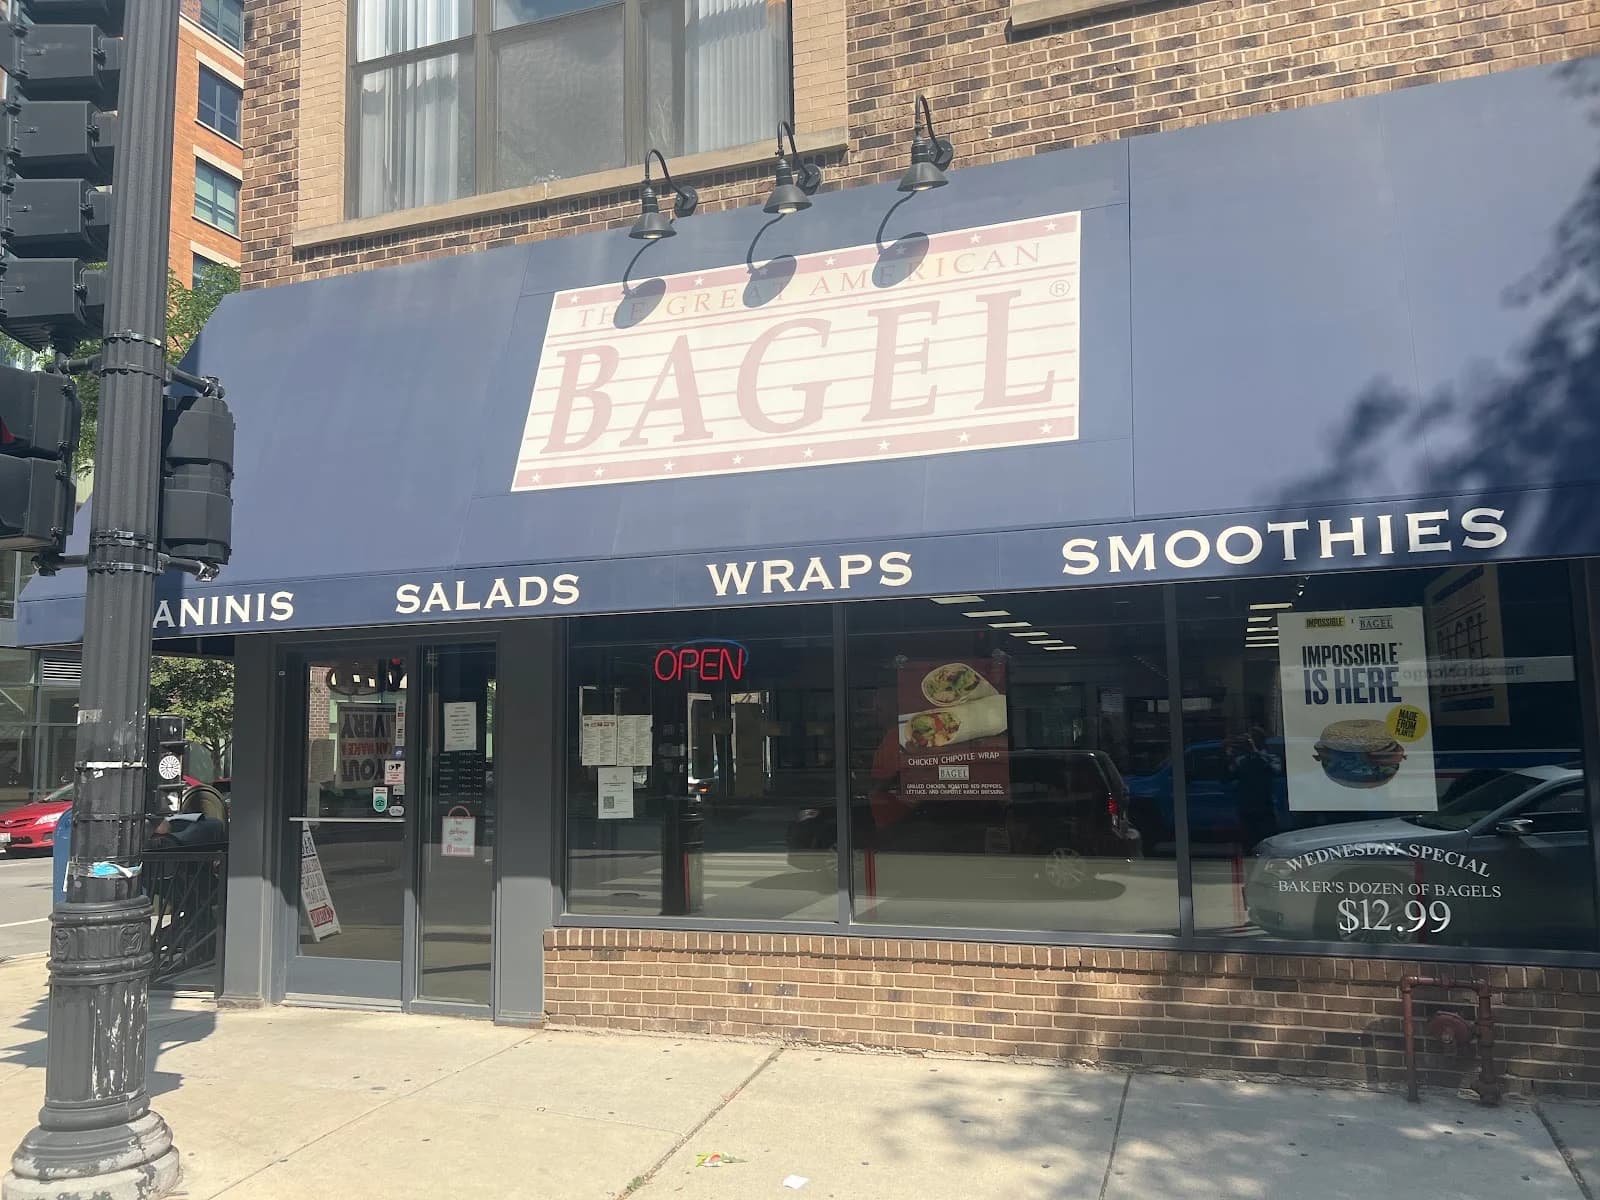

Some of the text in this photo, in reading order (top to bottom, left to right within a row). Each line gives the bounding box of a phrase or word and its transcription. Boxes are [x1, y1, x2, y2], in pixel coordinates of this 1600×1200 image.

[578, 242, 1041, 328] THE GREAT AMERICAN
[539, 289, 1056, 455] BAGEL
[1061, 507, 1508, 577] SMOOTHIES
[706, 551, 913, 597] WRAPS
[152, 591, 294, 628] ANINIS
[395, 573, 580, 614] SALADS
[1306, 617, 1344, 628] IMPOSSIBLE
[1360, 618, 1393, 629] BAGEL
[654, 648, 743, 681] OPEN
[1302, 643, 1399, 668] IMPOSSIBLE
[1304, 668, 1328, 705] IS
[1334, 667, 1402, 704] HERE
[1396, 719, 1417, 730] FROM
[1398, 709, 1419, 721] MADE
[908, 751, 1000, 766] CHICKEN CHIPOTLE WRAP
[940, 769, 967, 778] BAGEL
[1286, 843, 1491, 877] WEDNESDAY SPECIAL
[1278, 880, 1502, 898] BAKER'S DOZEN OF BAGELS
[1337, 898, 1451, 933] $12.99
